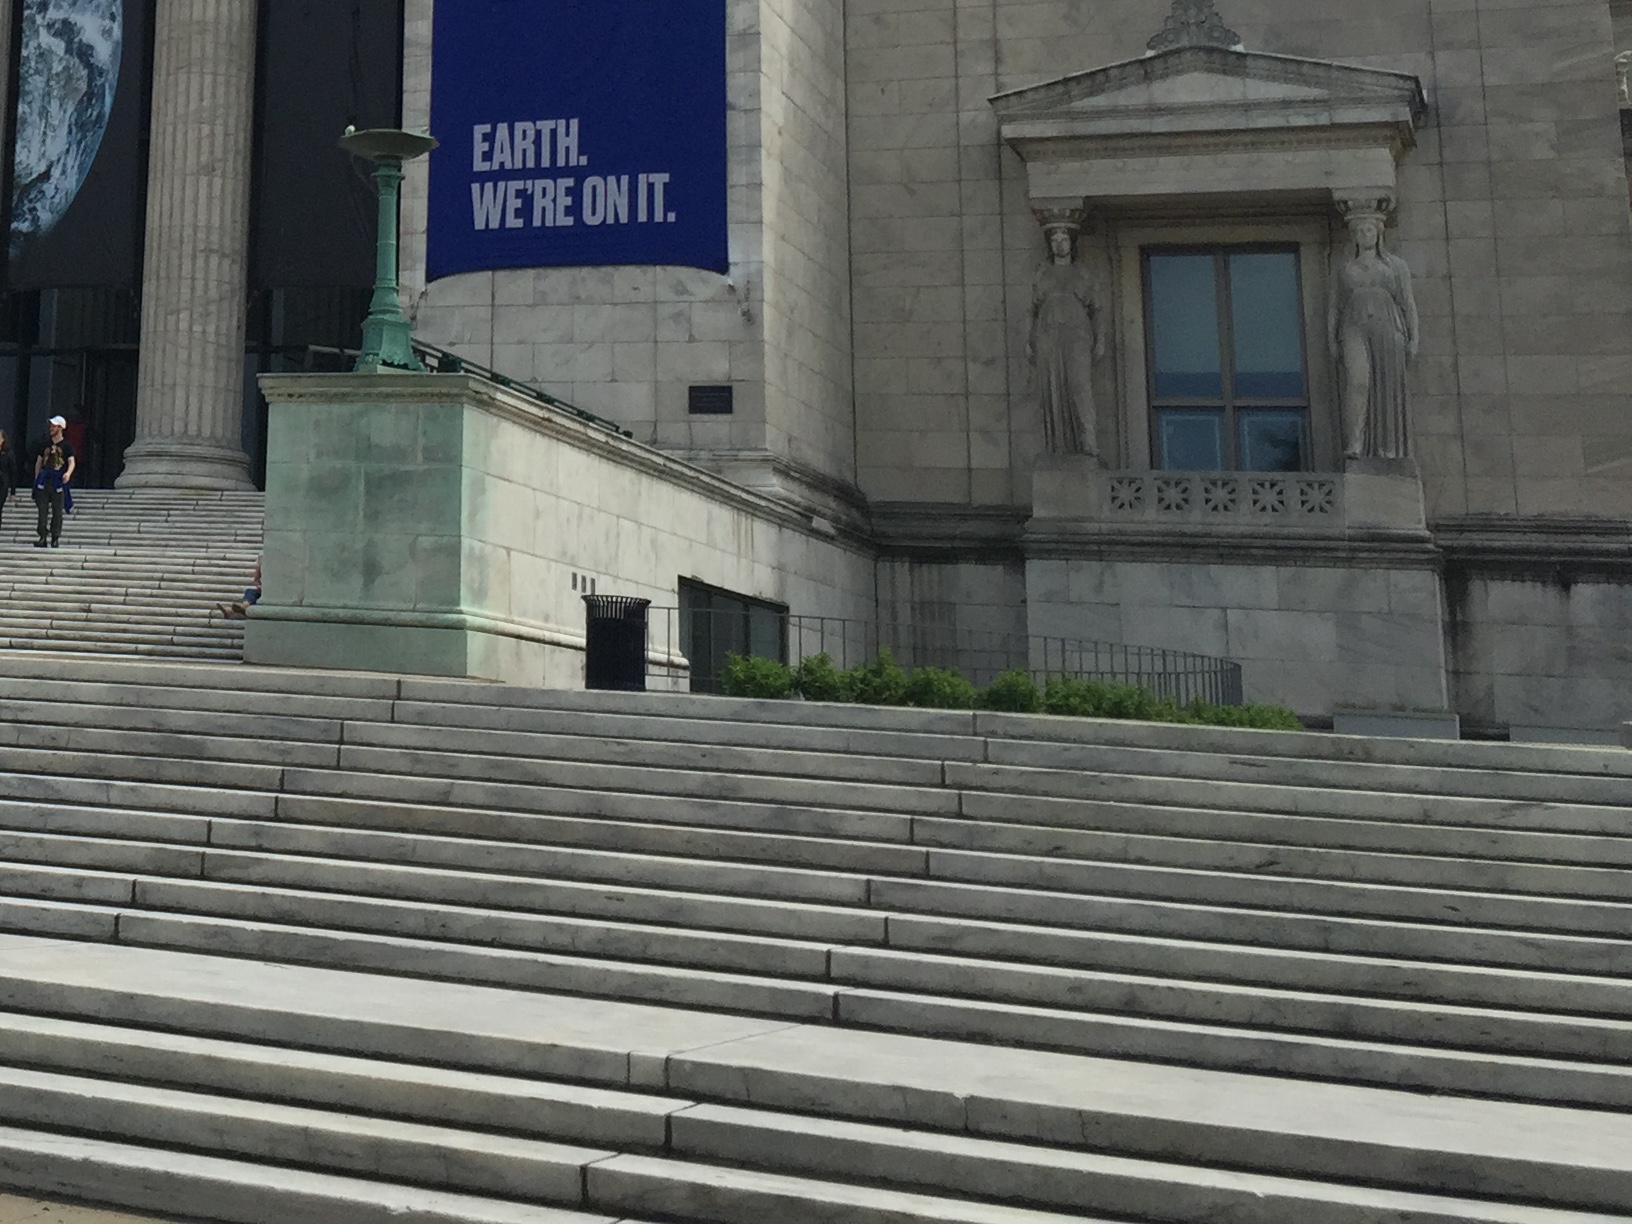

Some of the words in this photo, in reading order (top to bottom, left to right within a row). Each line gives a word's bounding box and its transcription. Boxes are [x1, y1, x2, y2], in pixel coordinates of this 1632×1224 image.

[473, 118, 588, 172] EARTH.
[471, 177, 575, 231] WE'RE
[582, 174, 630, 226] ON
[637, 172, 676, 223] IT.
